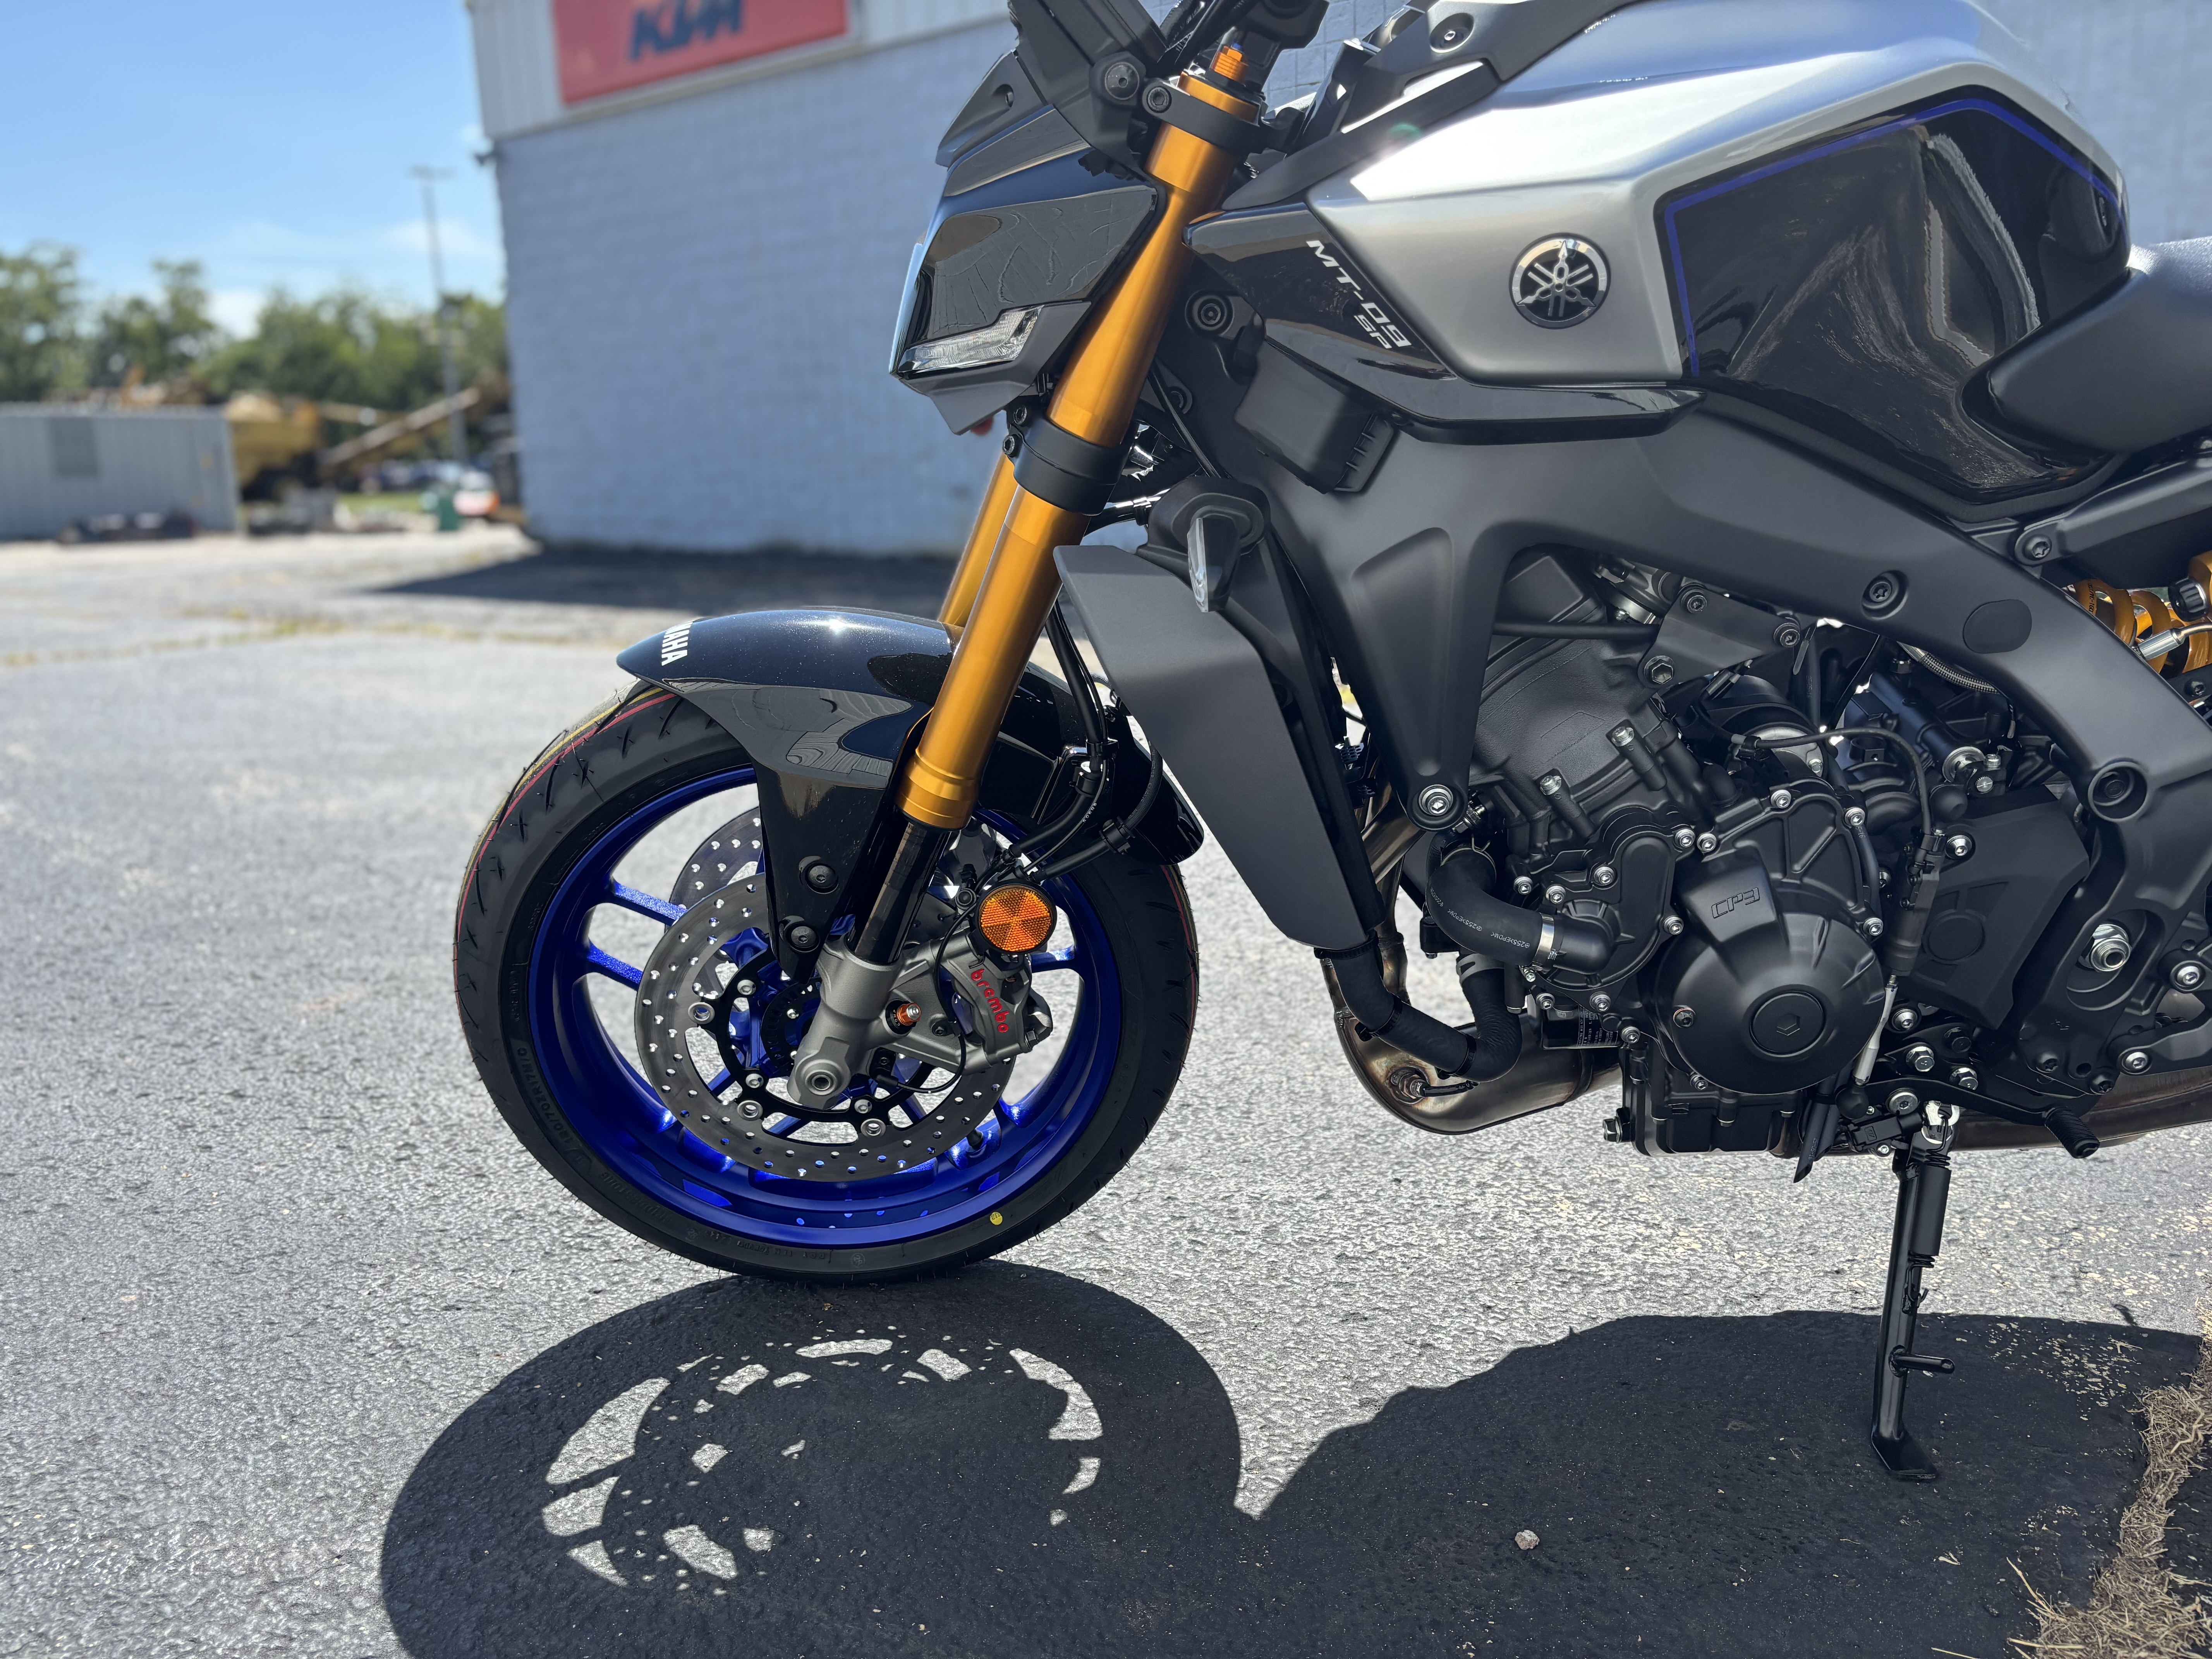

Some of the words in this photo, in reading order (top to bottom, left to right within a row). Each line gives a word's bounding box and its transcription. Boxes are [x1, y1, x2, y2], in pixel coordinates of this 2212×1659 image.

[1306, 240, 1412, 347] MT-09
[1354, 314, 1392, 349] SP
[1711, 887, 1760, 919] CP3
[971, 968, 1009, 1033] brembo
